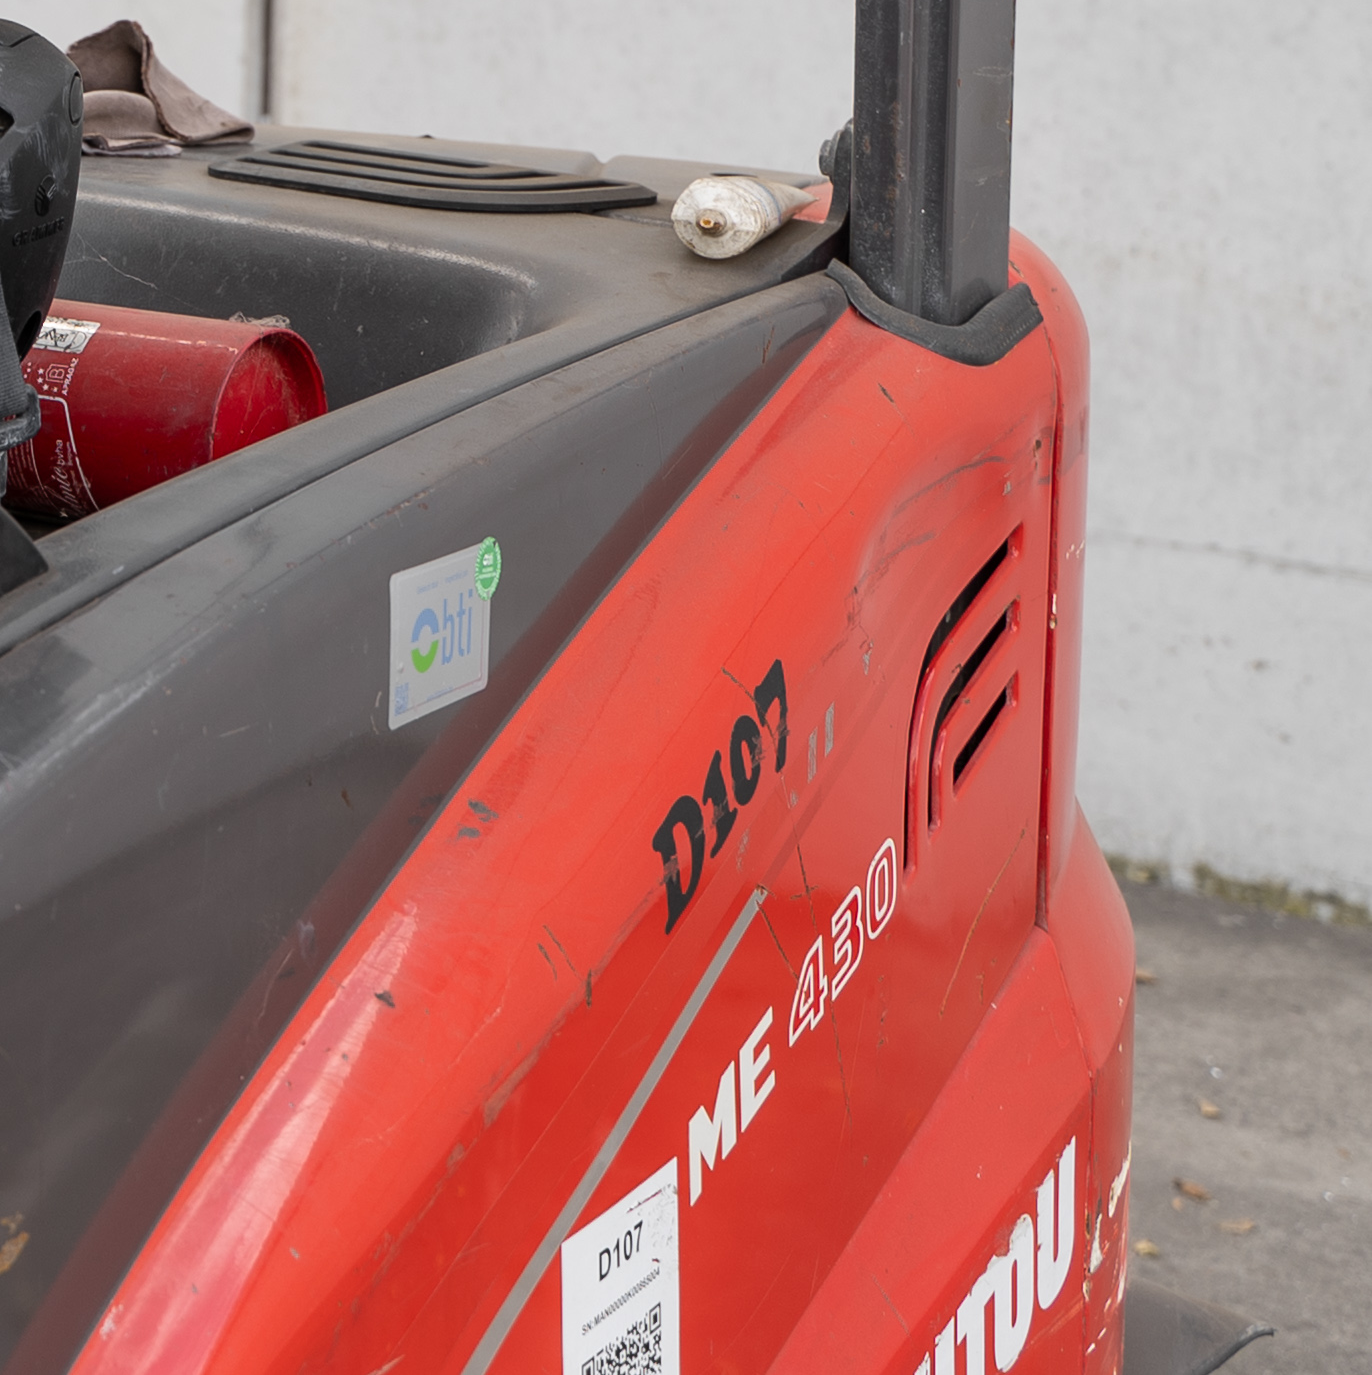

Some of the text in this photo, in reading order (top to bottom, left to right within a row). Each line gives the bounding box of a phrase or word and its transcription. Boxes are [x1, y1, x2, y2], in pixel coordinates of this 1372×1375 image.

[652, 658, 789, 936] D107
[688, 837, 898, 1207] ME 430
[598, 1219, 644, 1282] D107
